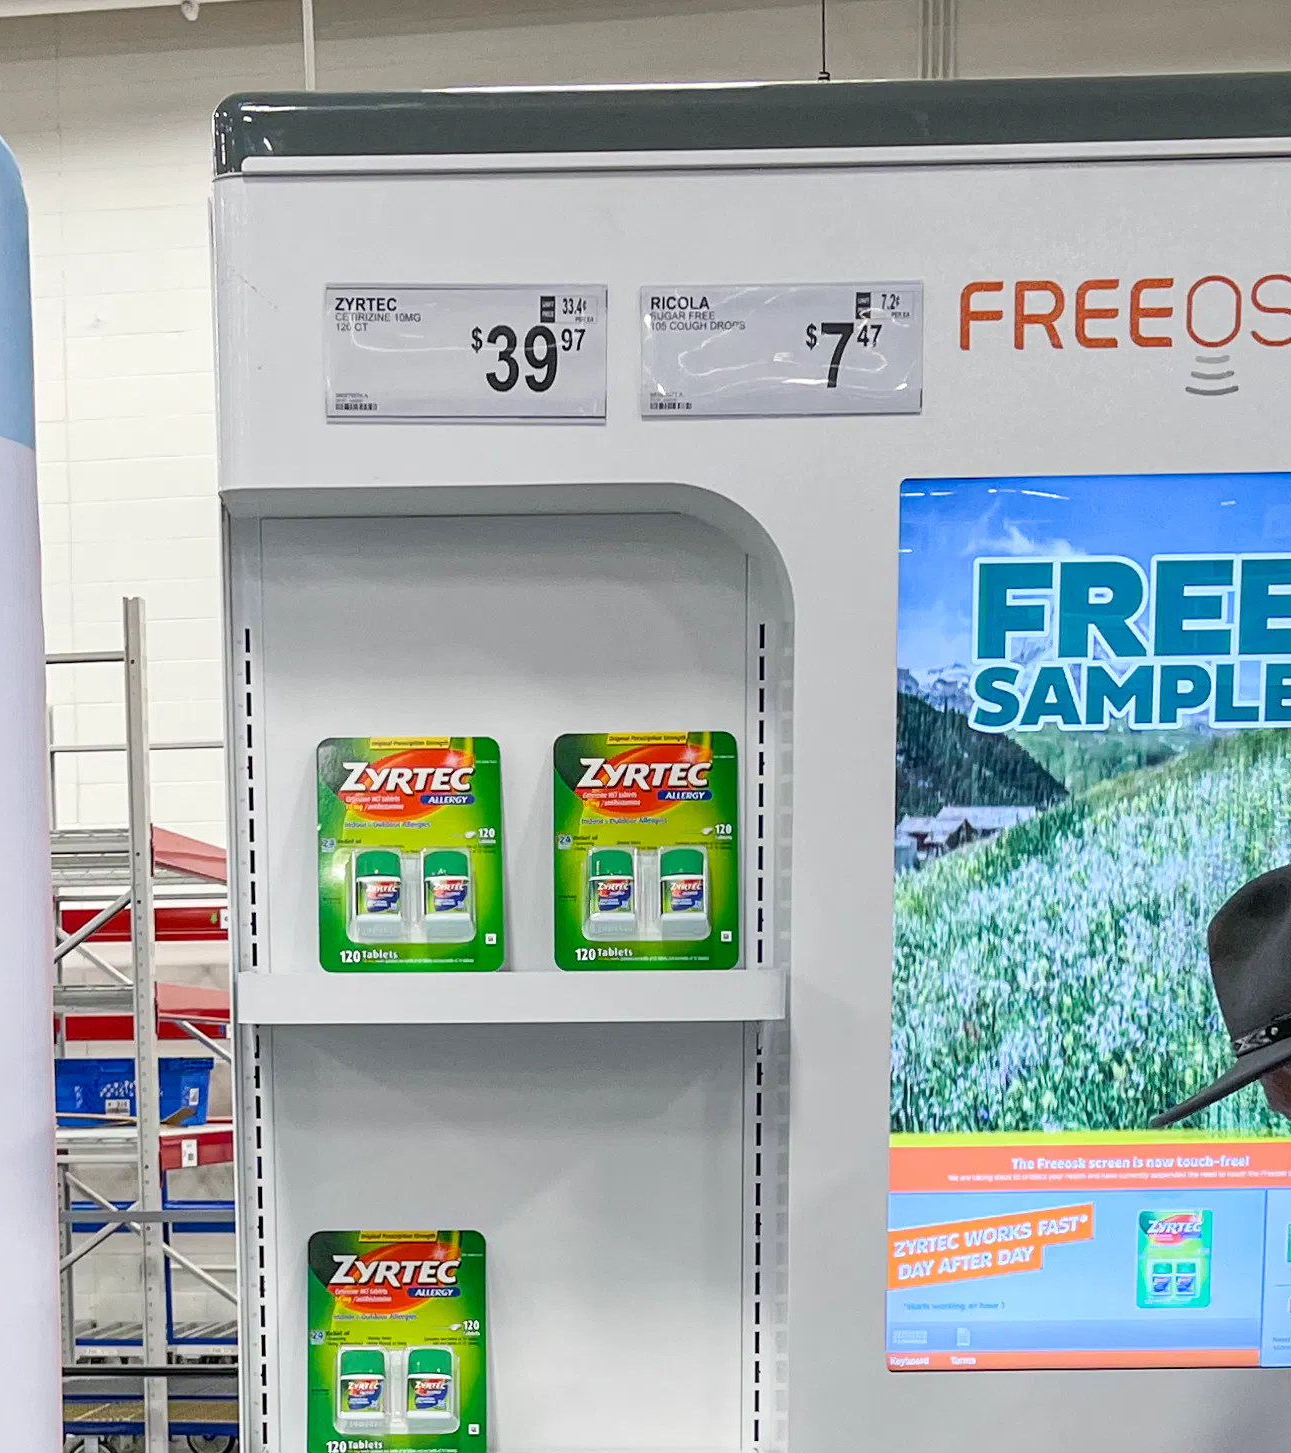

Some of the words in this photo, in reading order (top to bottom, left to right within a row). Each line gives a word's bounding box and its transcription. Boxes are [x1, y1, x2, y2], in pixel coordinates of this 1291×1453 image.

[335, 297, 398, 312] ZYRTEC
[650, 296, 711, 310] RICOLA
[394, 312, 422, 323] 10MG
[689, 311, 715, 321] FREE
[669, 320, 708, 331] COUGH
[341, 762, 475, 793] ZYRTEC
[576, 758, 712, 790] ZYRTEC
[427, 795, 469, 805] ALLERGY
[664, 790, 706, 801] ALLERGY
[715, 823, 733, 836] 120
[893, 1233, 960, 1258] ZYRTEC
[963, 1222, 1032, 1247] WORKS
[897, 1259, 935, 1280] DAY
[938, 1252, 993, 1274] AFTER
[997, 1245, 1036, 1266] DAY
[329, 1254, 461, 1287] ZYRTEC
[414, 1287, 455, 1298] ALLERGY
